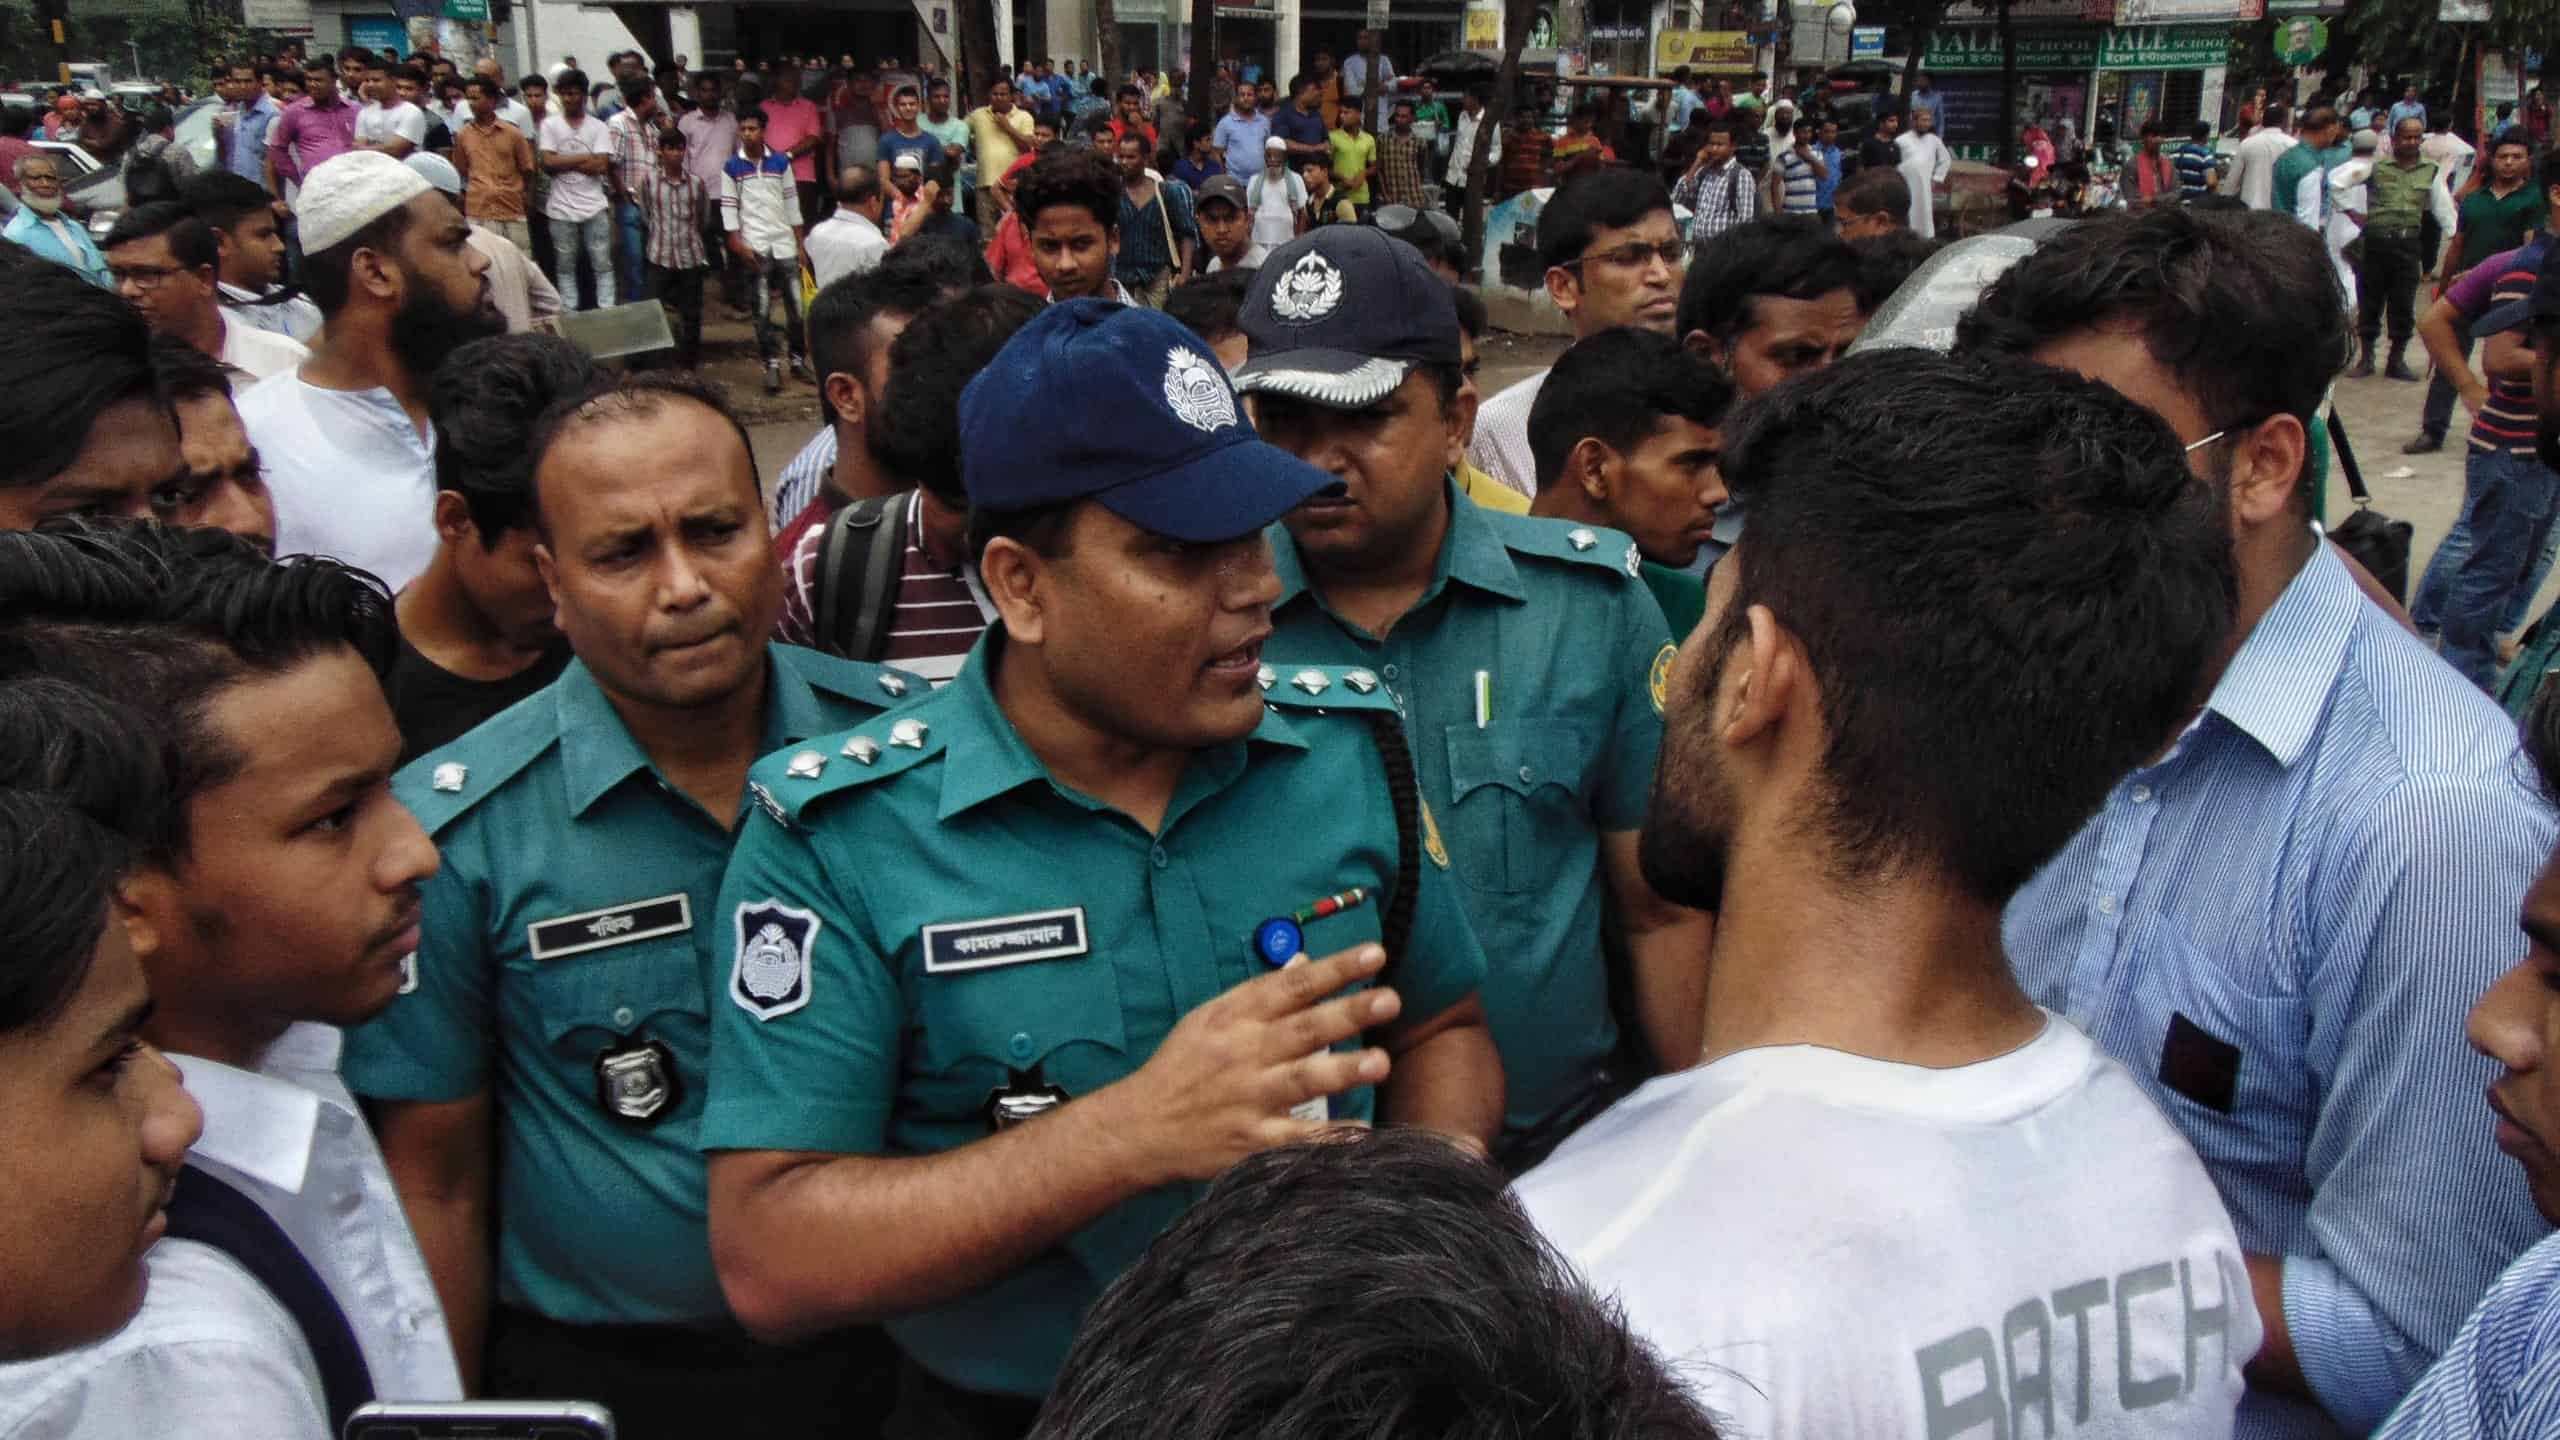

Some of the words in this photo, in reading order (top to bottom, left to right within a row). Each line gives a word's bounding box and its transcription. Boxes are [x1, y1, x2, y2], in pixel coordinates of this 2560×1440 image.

[2106, 27, 2169, 50] YALE
[2173, 38, 2225, 49] SCHOOL
[953, 925, 1064, 954] কামরুজ্জামান
